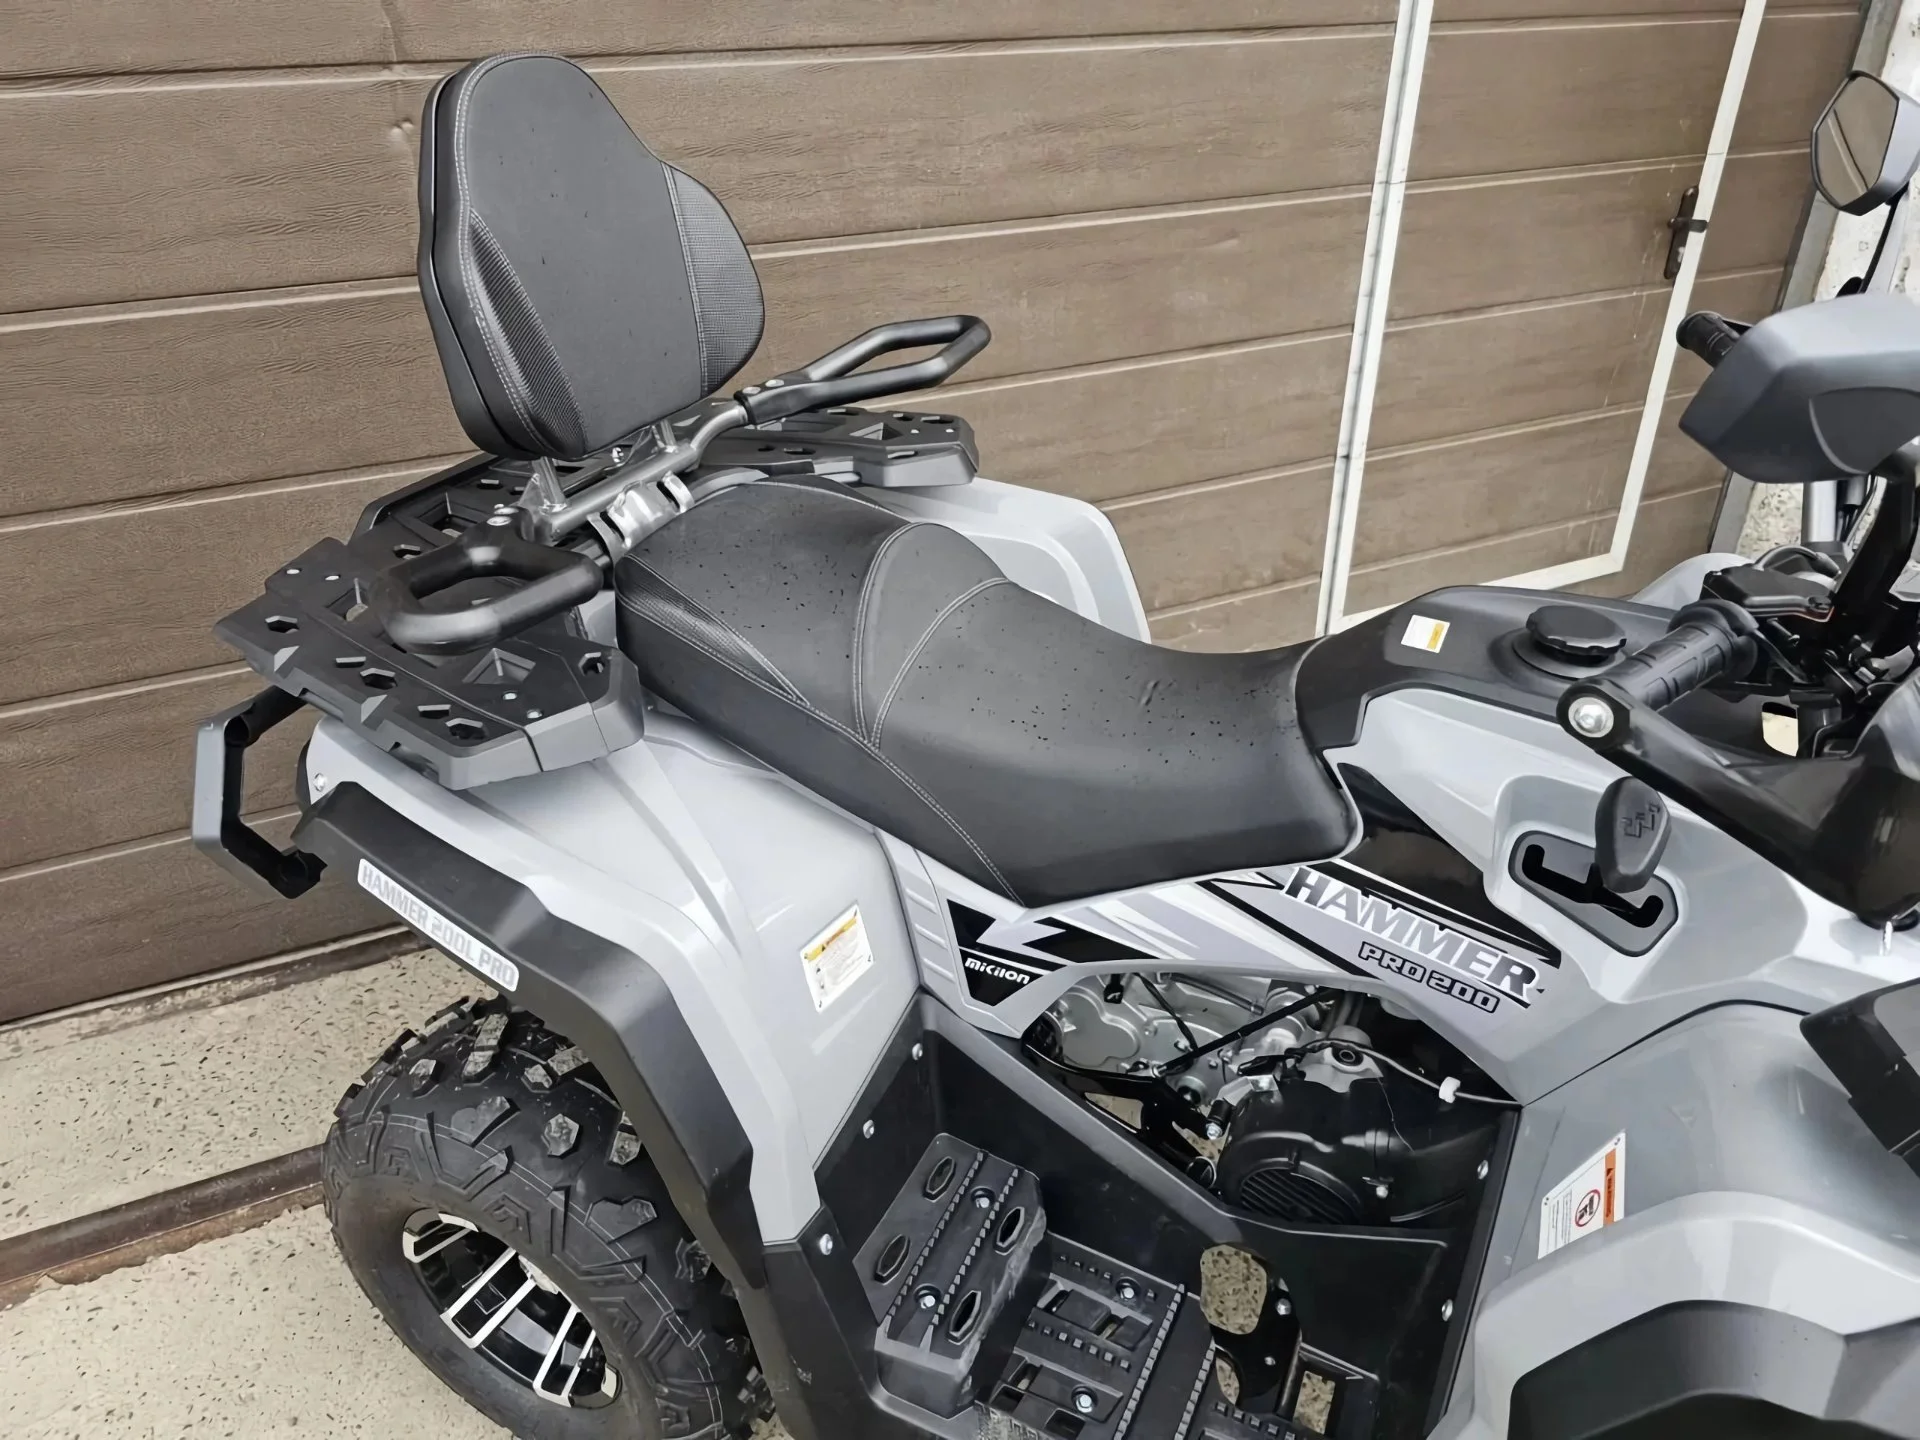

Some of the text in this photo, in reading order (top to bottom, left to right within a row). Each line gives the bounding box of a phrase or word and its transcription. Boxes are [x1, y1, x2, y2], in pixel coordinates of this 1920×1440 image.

[362, 864, 429, 930] HAMMER
[478, 947, 516, 988] PRO
[1281, 866, 1540, 998] HAMMER
[1358, 941, 1500, 1014] PRO 200
